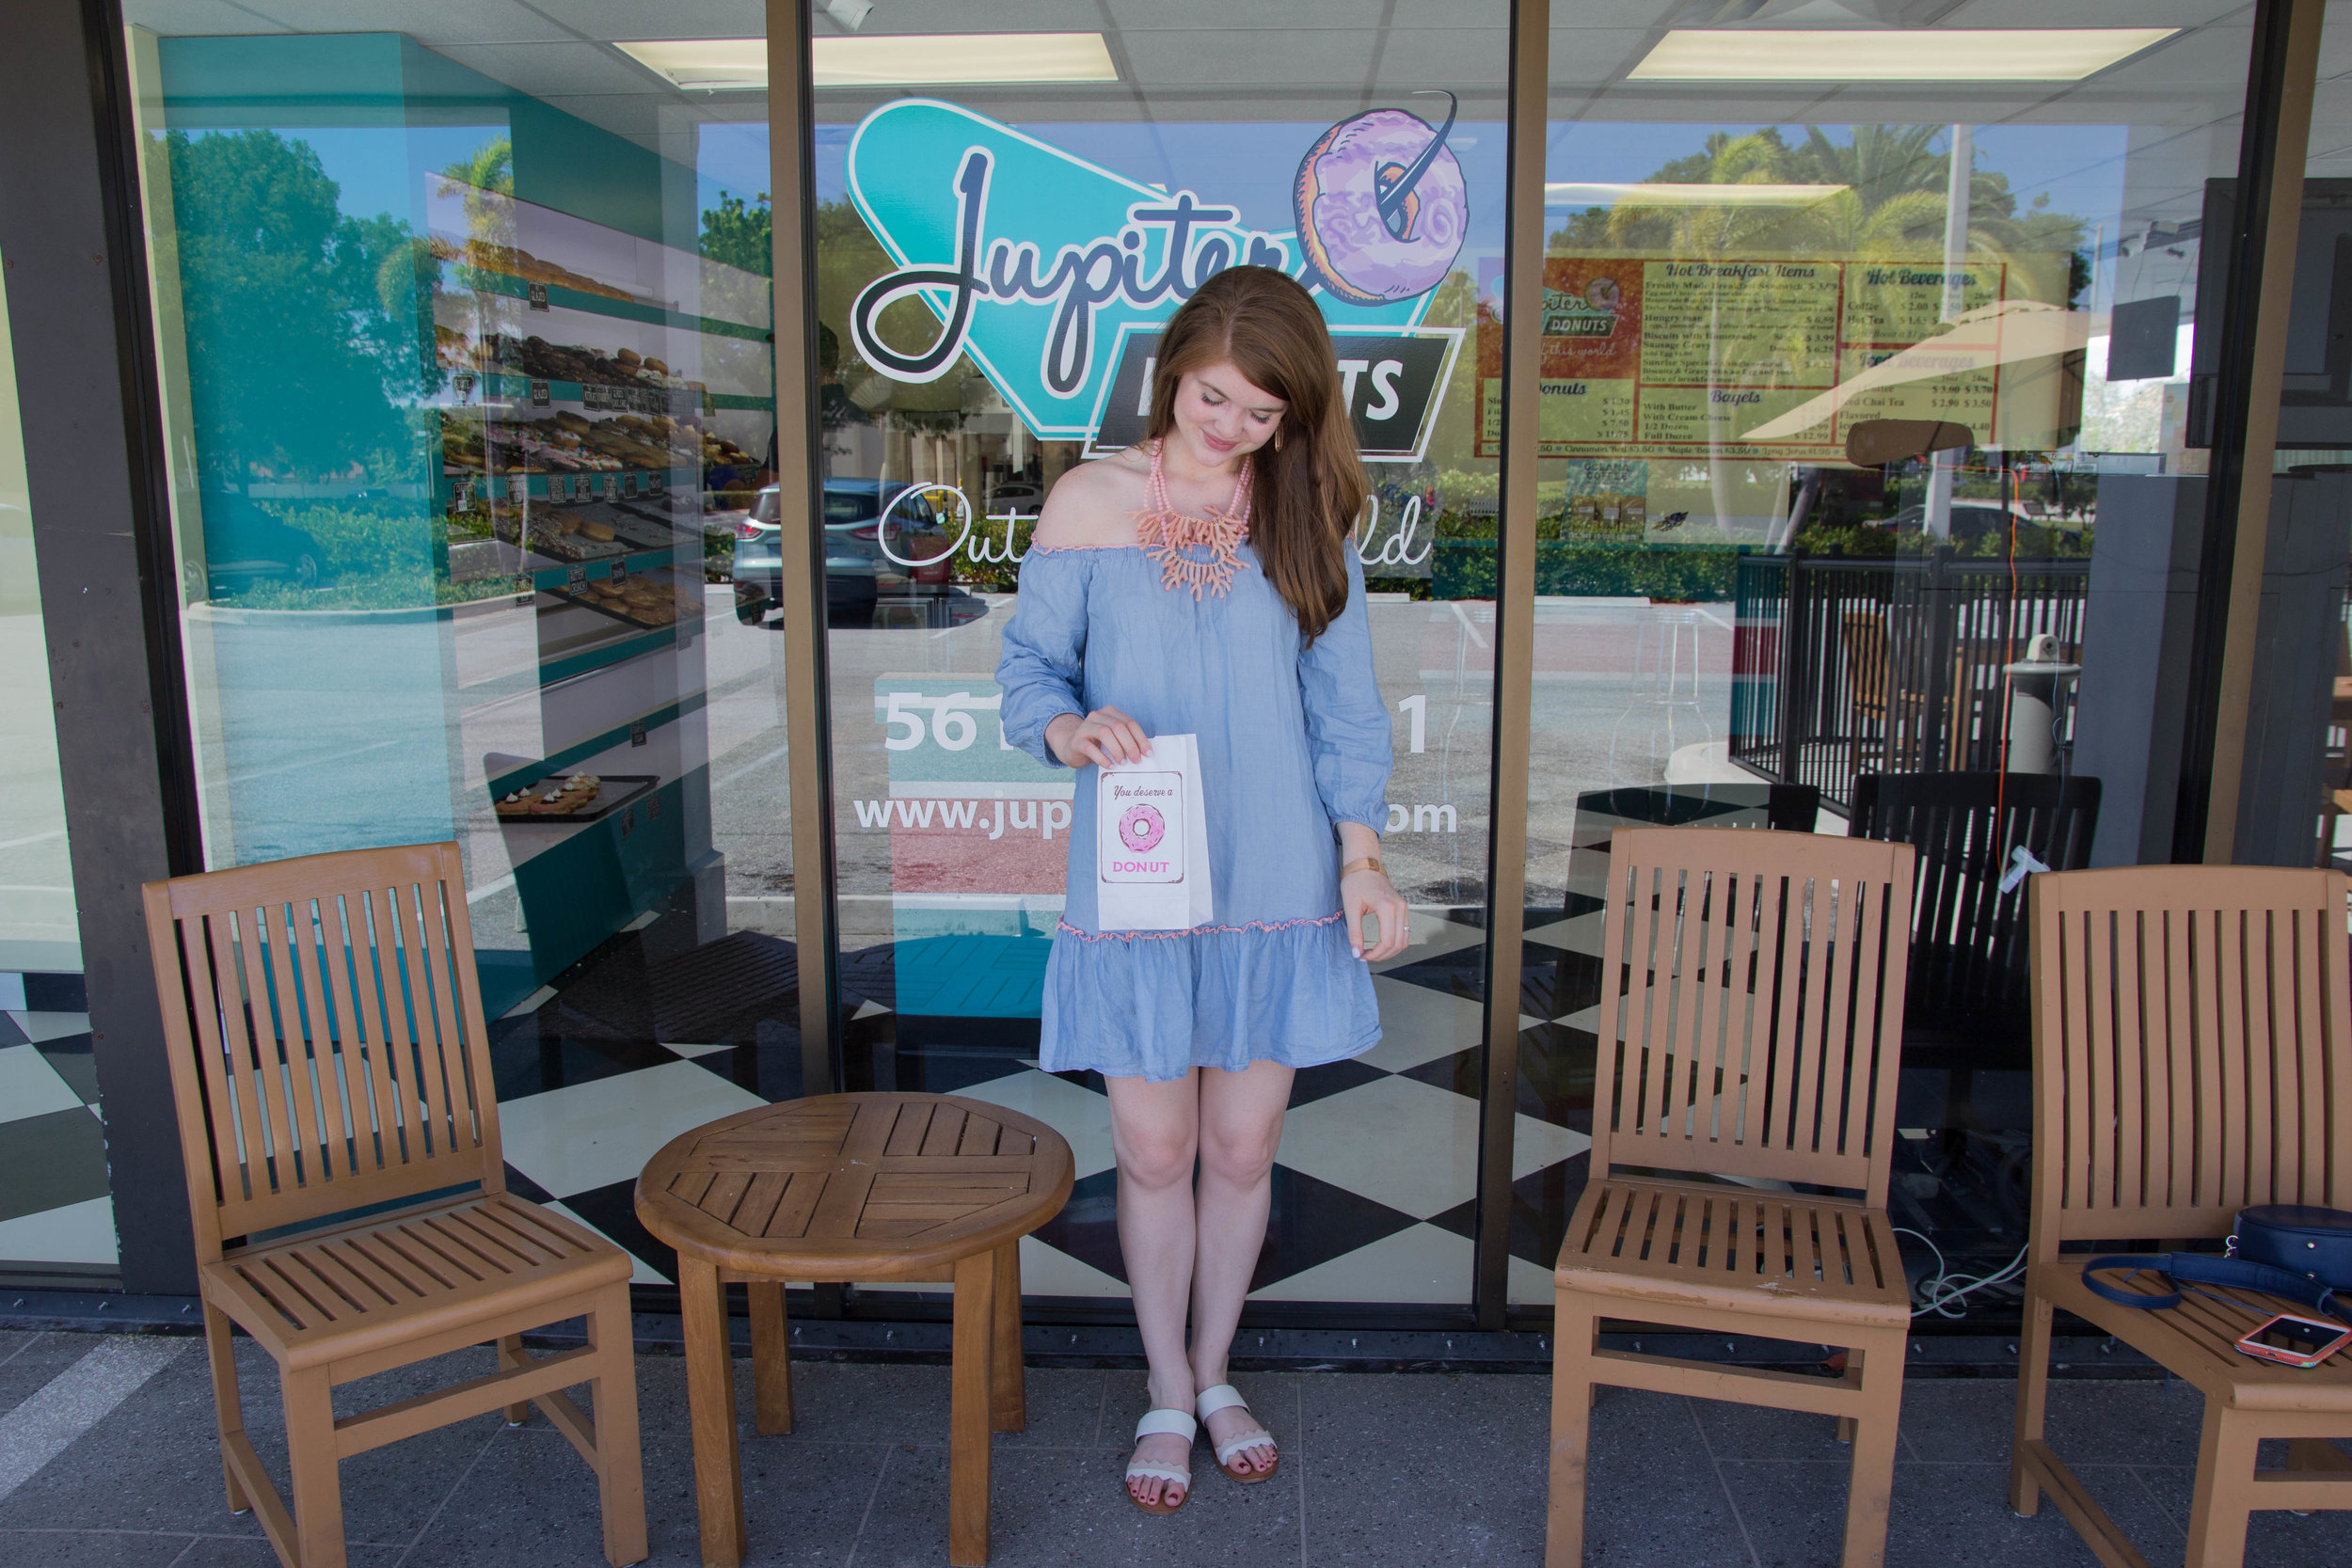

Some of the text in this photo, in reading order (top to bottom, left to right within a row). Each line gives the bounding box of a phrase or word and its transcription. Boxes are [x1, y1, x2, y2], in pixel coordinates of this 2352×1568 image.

[1666, 263, 1693, 277] Hot
[1775, 265, 1816, 277] Items
[1867, 269, 1896, 285] Hot
[1644, 314, 1679, 324] Hungry
[1550, 320, 1608, 331] DONUTS
[1549, 342, 1575, 356] this
[1578, 341, 1616, 356] world
[1710, 389, 1761, 405] Bagels
[1863, 397, 1885, 406] Chai
[1887, 397, 1905, 406] Tea
[1667, 403, 1697, 411] Butter
[1667, 413, 1698, 421] Cream
[1838, 411, 1881, 420] Flavored
[878, 481, 1040, 567] Out
[1114, 784, 1174, 800] You deserve a
[1113, 861, 1170, 873] DONUT
